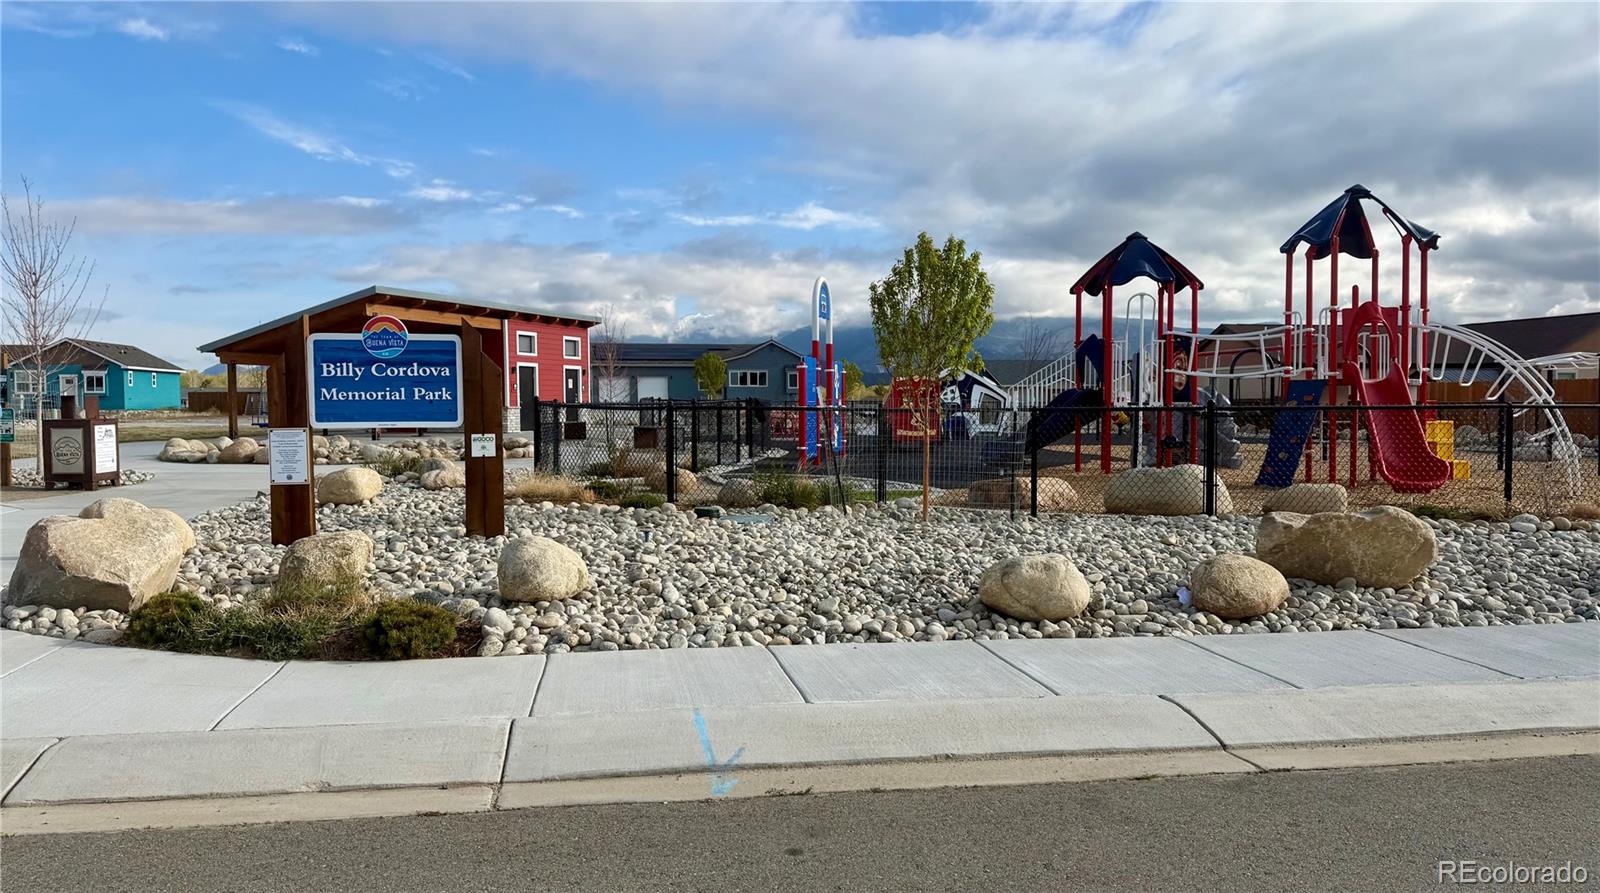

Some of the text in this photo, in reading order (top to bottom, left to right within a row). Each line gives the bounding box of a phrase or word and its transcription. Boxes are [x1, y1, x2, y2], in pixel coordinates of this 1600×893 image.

[365, 339, 387, 347] BUENA
[320, 362, 451, 381] Billy Cordova
[320, 387, 453, 401] Memorial Park
